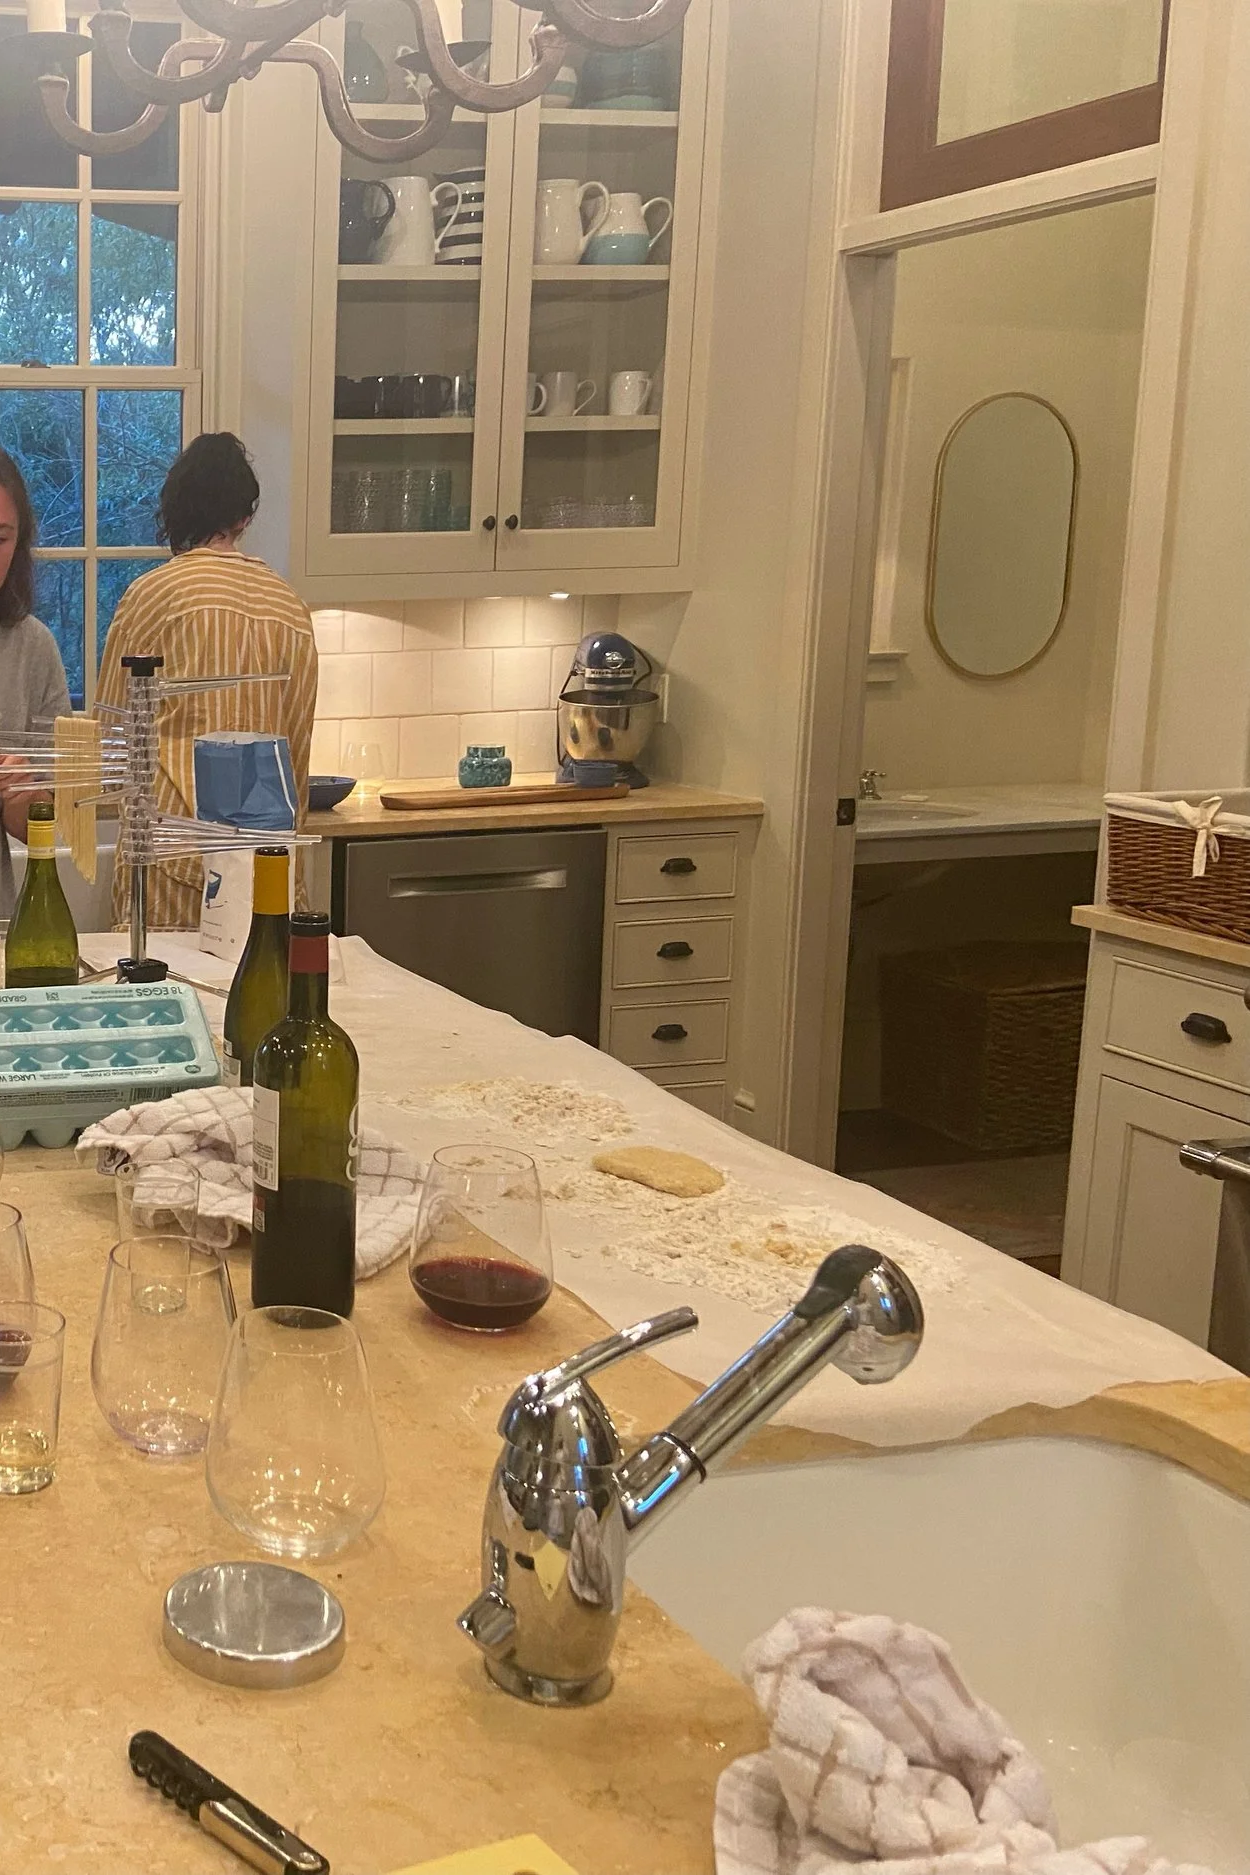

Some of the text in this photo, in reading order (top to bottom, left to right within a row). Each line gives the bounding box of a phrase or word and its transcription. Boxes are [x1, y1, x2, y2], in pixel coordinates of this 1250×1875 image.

[135, 987, 169, 997] EGGS
[170, 986, 183, 995] 18
[8, 1073, 37, 1083] LARGE
